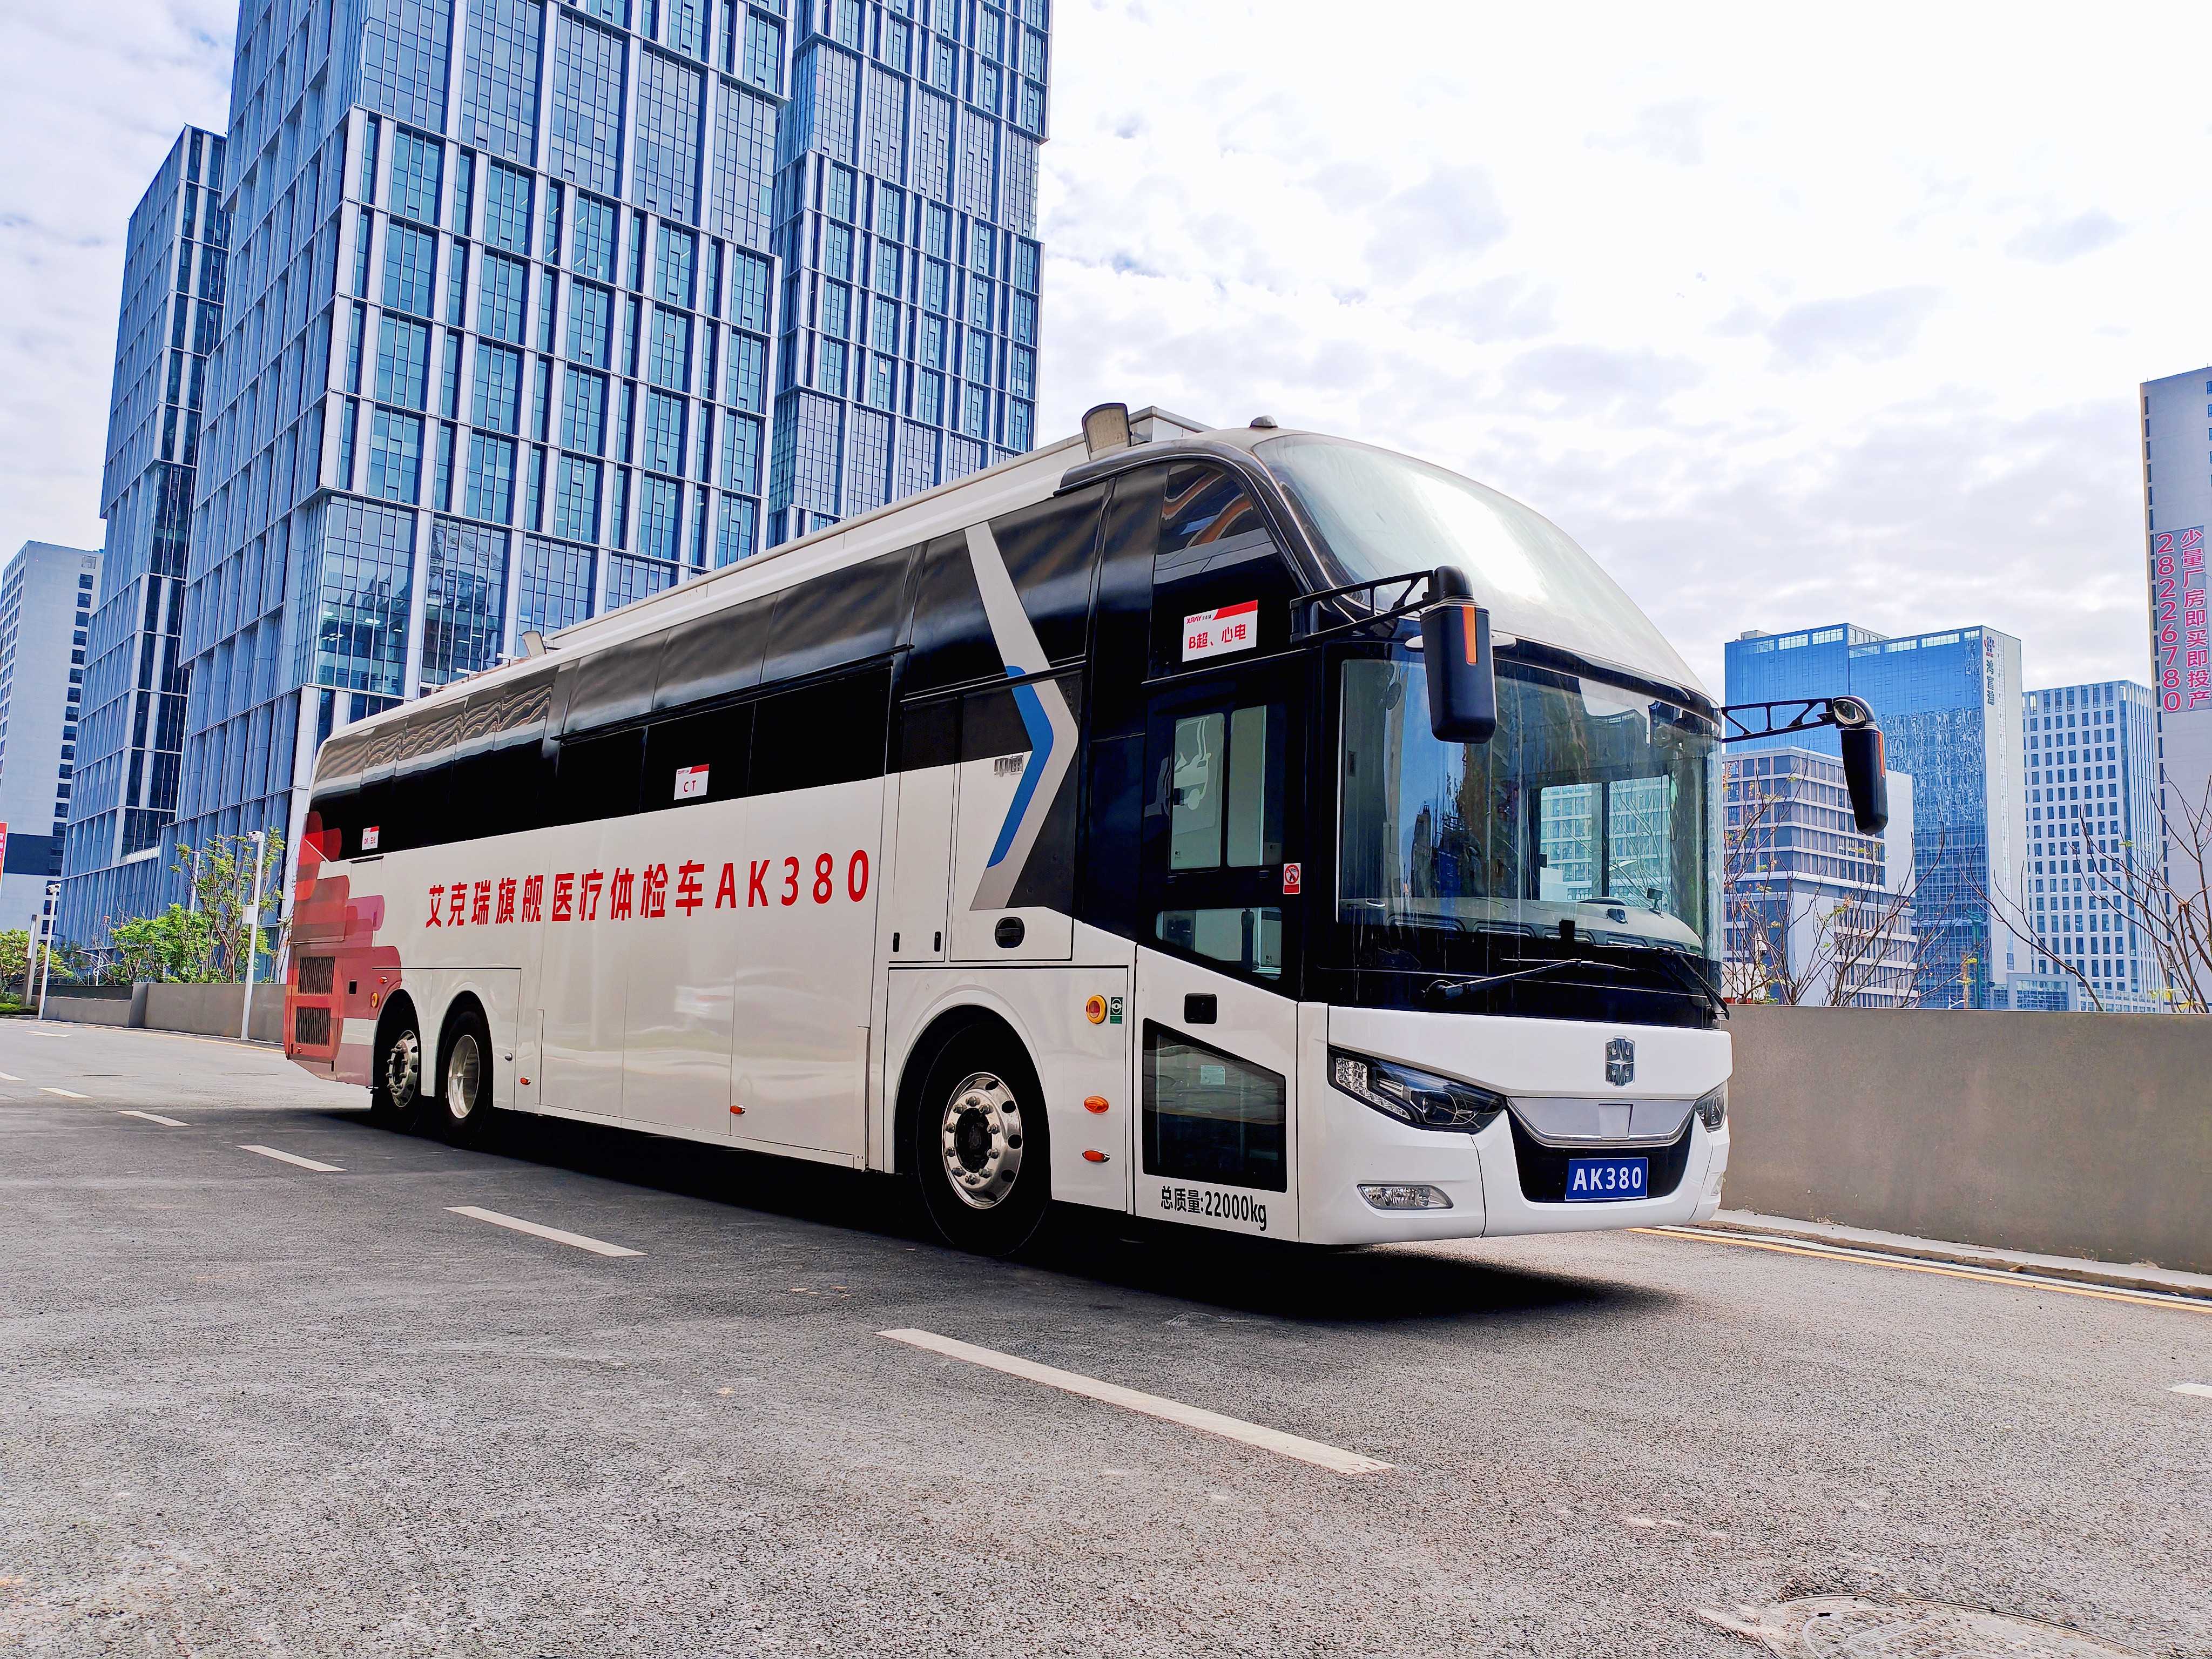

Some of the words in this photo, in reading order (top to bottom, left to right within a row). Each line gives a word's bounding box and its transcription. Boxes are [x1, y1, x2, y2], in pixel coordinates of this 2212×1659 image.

[1188, 623, 1246, 649] B超、心电
[2157, 532, 2182, 712] 28226780
[2180, 529, 2211, 709] 少量厂房即买即投产
[1573, 1166, 1642, 1191] AK380
[1161, 1185, 1267, 1231] 总质量:22000kg
